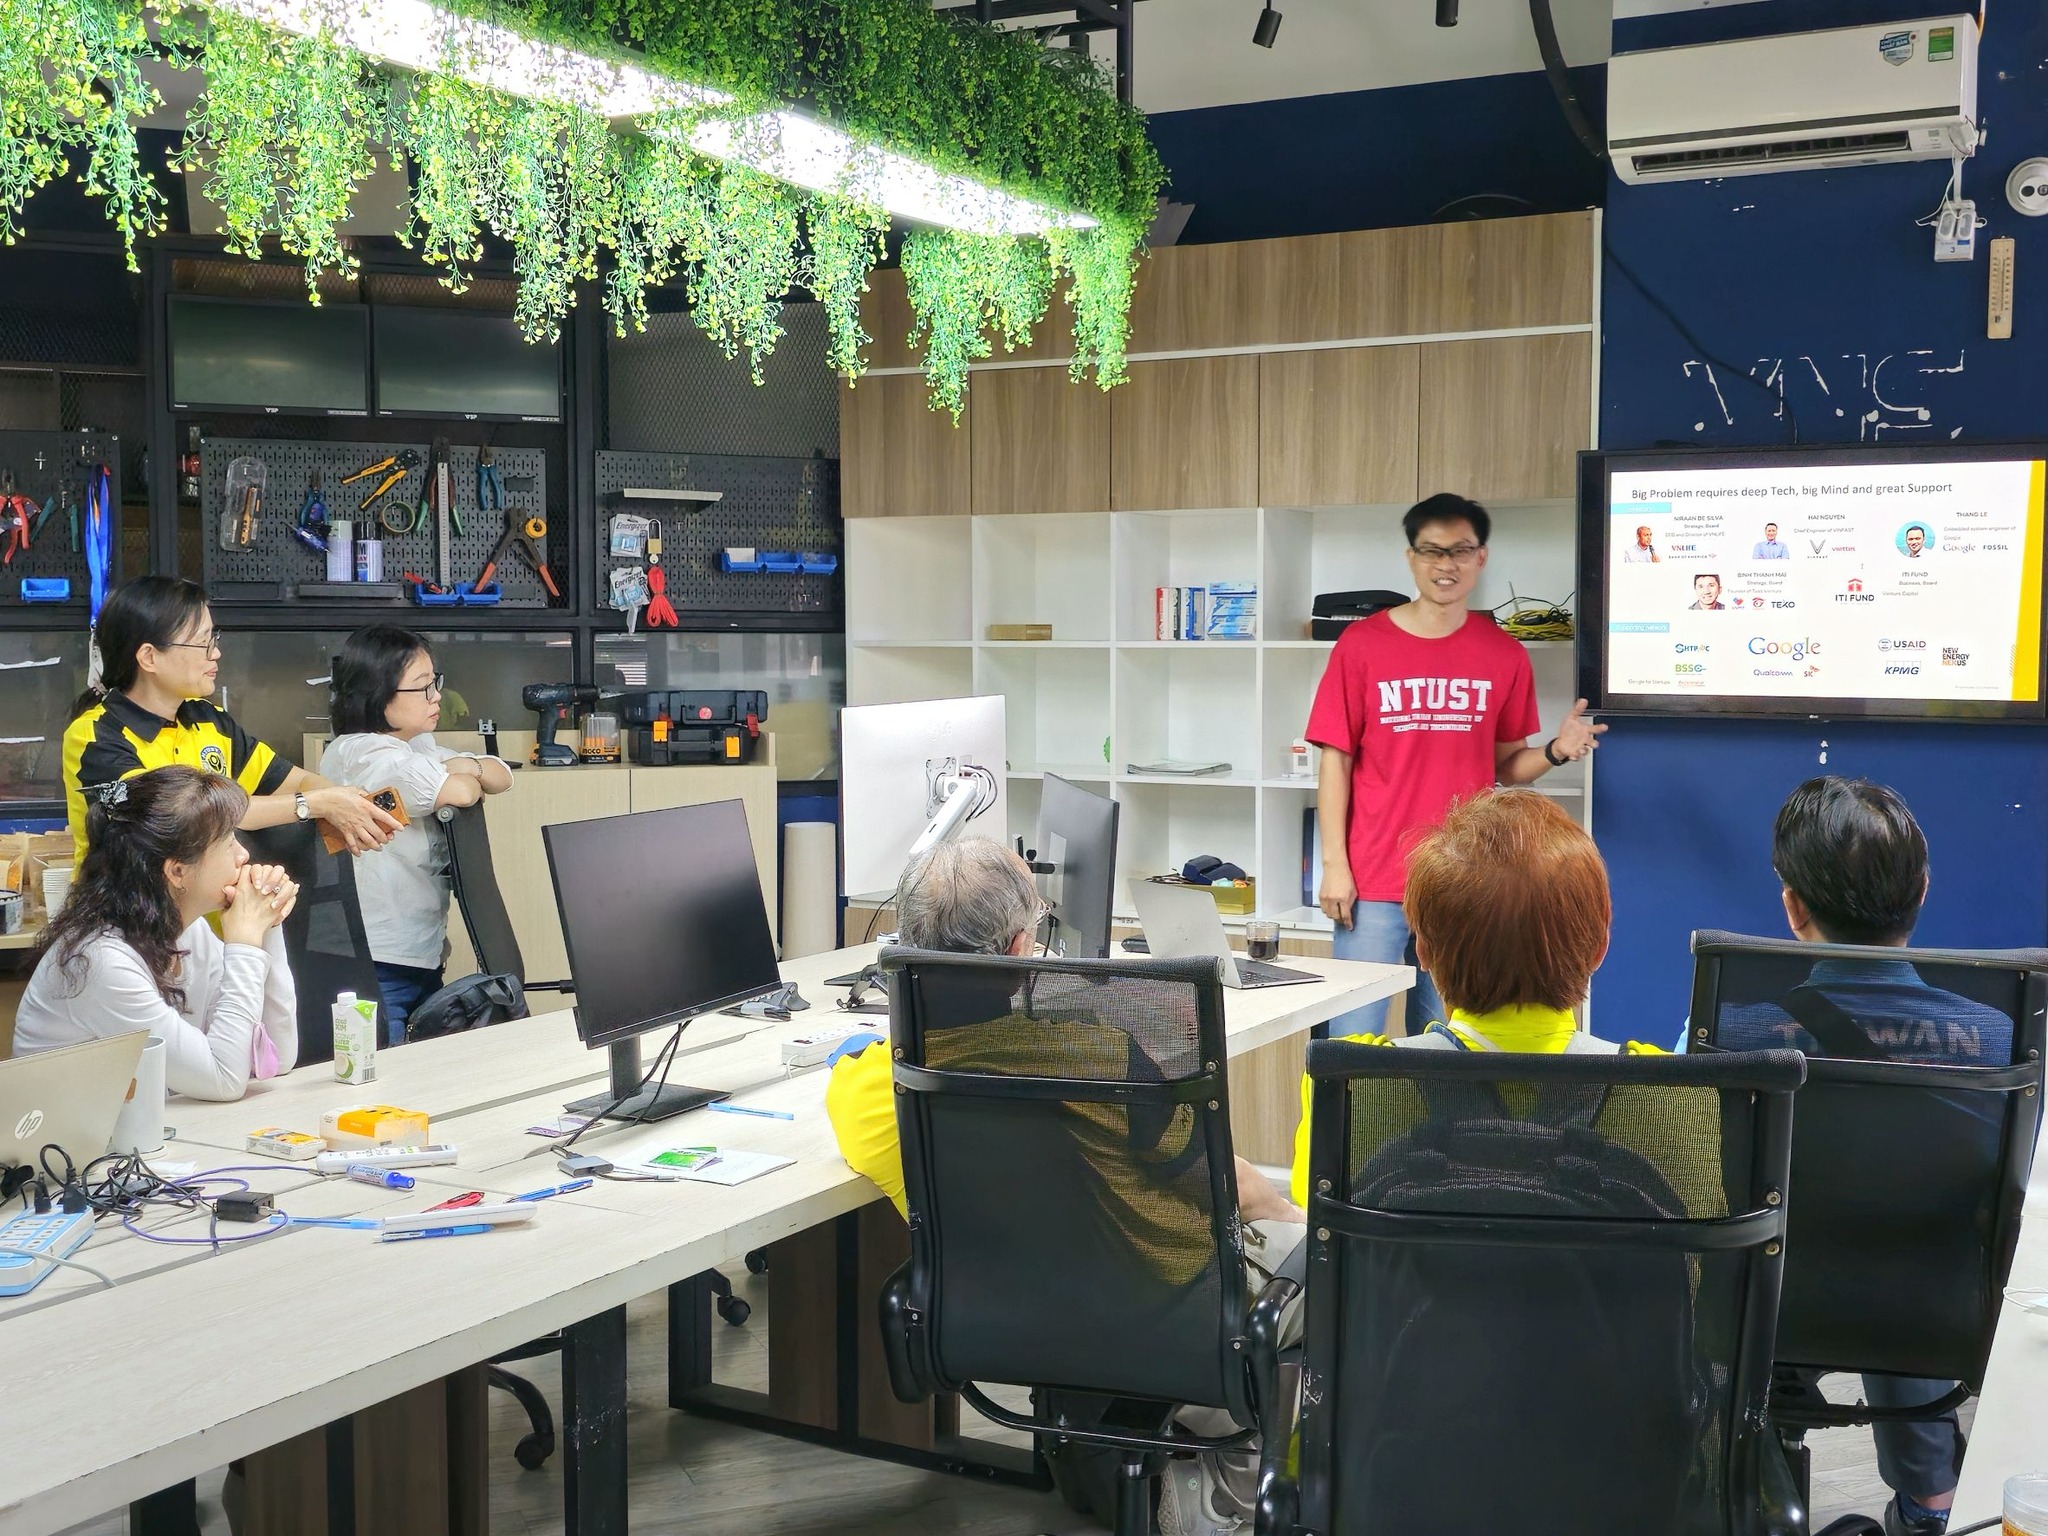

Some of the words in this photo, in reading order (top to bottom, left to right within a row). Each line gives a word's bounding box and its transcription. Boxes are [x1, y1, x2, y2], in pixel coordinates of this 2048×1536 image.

[1632, 489, 1647, 500] Big
[1650, 488, 1693, 499] Problem
[1695, 487, 1739, 499] requires
[1740, 486, 1768, 498] deep
[1770, 486, 1799, 498] Tech,
[1802, 485, 1818, 497] big
[1821, 484, 1850, 495] Mind
[1852, 484, 1872, 494] and
[1875, 484, 1905, 496] great
[1908, 483, 1953, 495] Support
[616, 522, 648, 532] Energizer
[1943, 543, 1976, 554] Google
[614, 570, 642, 589] Energizer
[1835, 594, 1848, 602] ITI
[1849, 594, 1875, 602] FUND
[1748, 637, 1821, 661] Google
[1893, 640, 1926, 648] USAID
[1884, 666, 1920, 675] KPMG
[1377, 677, 1493, 713] NTUST
[1771, 1018, 1981, 1057] TWAN
[16, 1111, 42, 1140] hp
